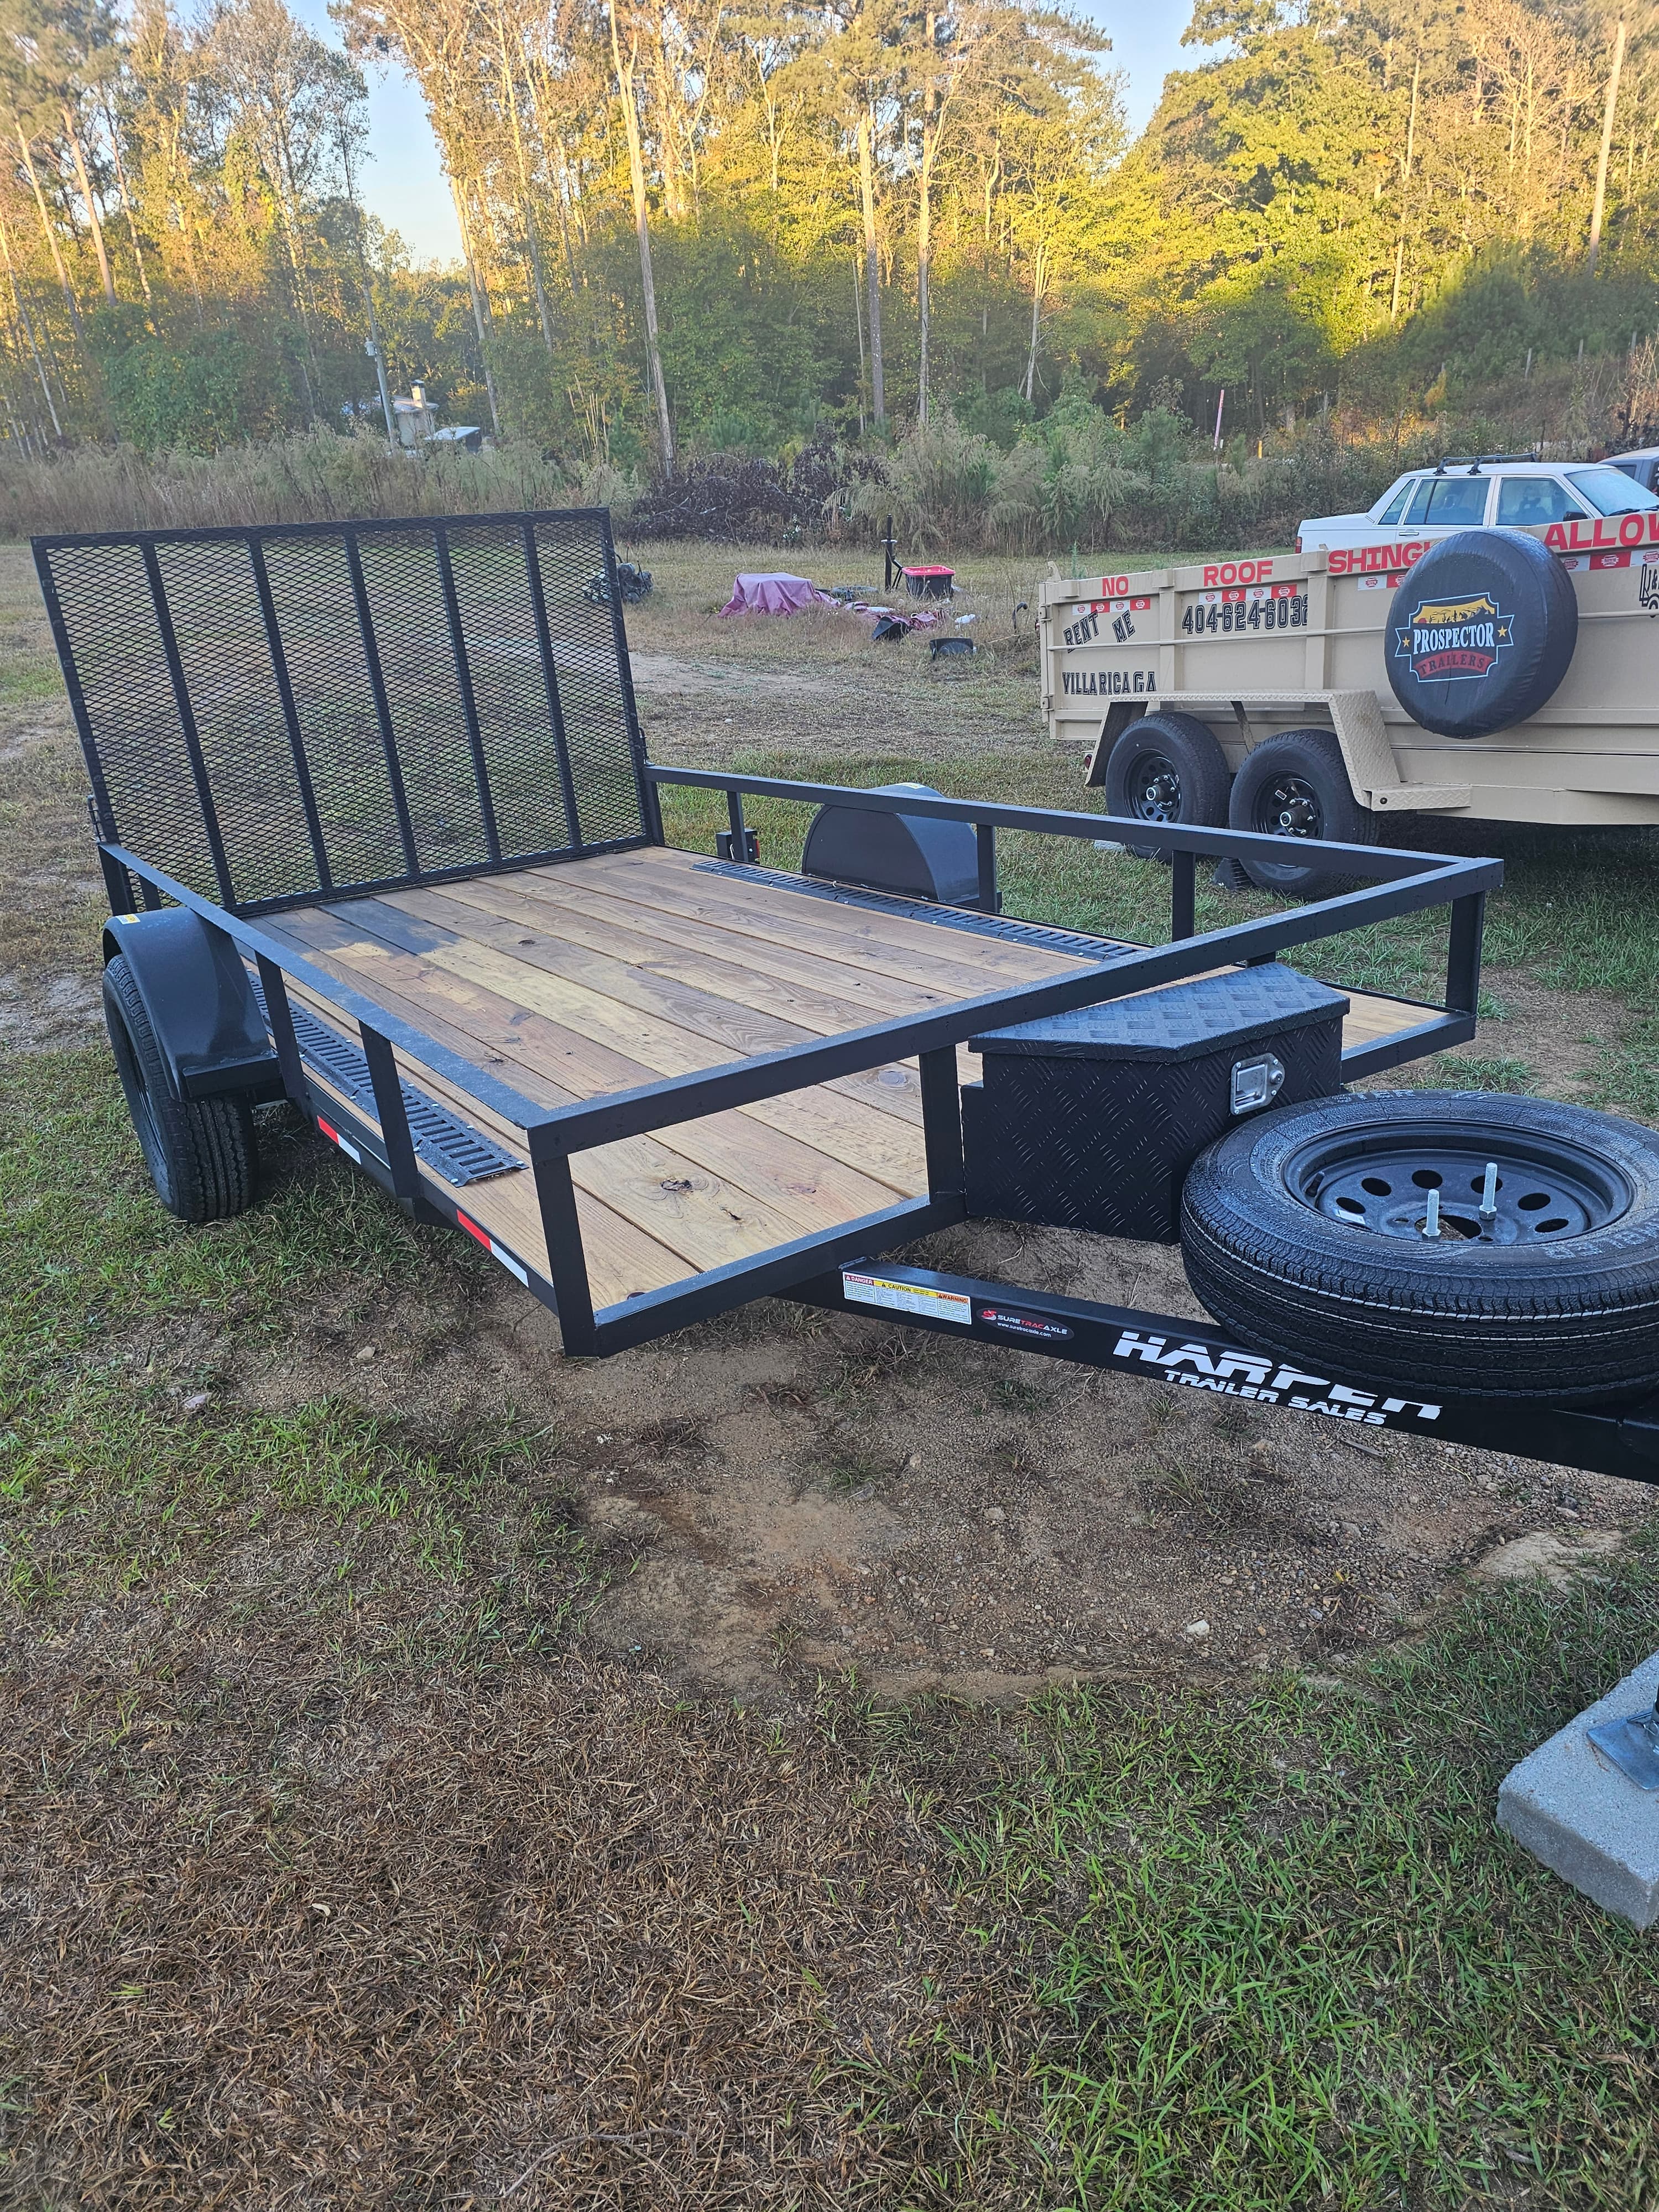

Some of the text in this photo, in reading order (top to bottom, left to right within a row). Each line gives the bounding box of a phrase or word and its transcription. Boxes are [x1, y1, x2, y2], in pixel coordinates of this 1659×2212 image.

[1102, 576, 1128, 597] NO
[1203, 560, 1273, 587] ROOF
[1063, 609, 1135, 654] RENT ME
[1413, 622, 1495, 655] PROSPECTOR
[1418, 652, 1484, 675] TRAILERS
[851, 1276, 873, 1285] DANGER
[888, 1284, 911, 1292] CAUTION
[942, 1295, 967, 1303] WARNING
[1164, 1369, 1387, 1425] TRAILER SALES
